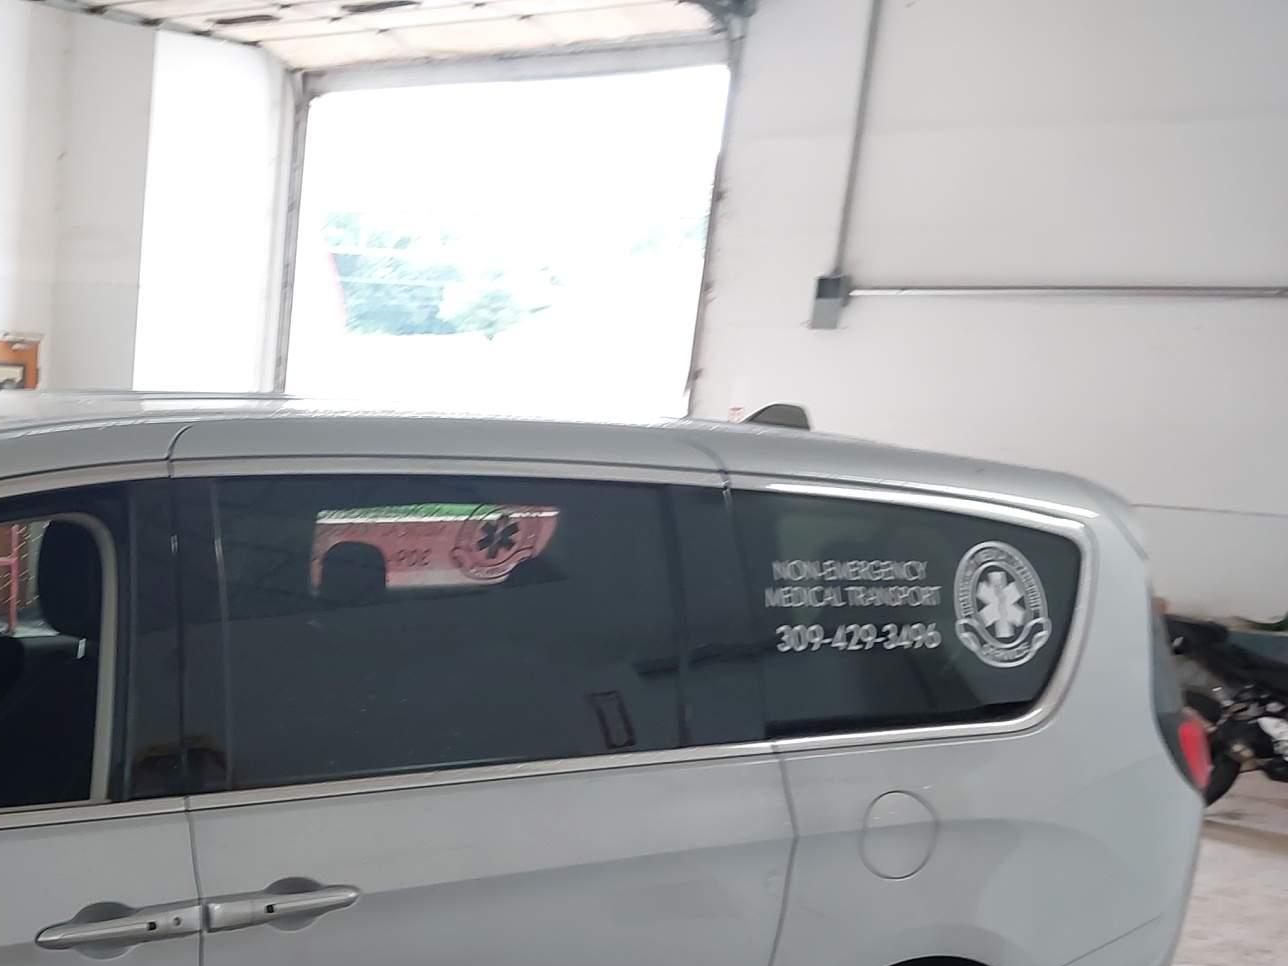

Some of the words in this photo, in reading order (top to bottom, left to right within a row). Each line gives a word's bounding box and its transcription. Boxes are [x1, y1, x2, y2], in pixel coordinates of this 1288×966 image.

[772, 559, 928, 581] NON-EMERGENCY
[765, 586, 845, 607] MEDICAL
[844, 585, 942, 606] TRANSPORT
[775, 622, 942, 652] 309-429-3496
